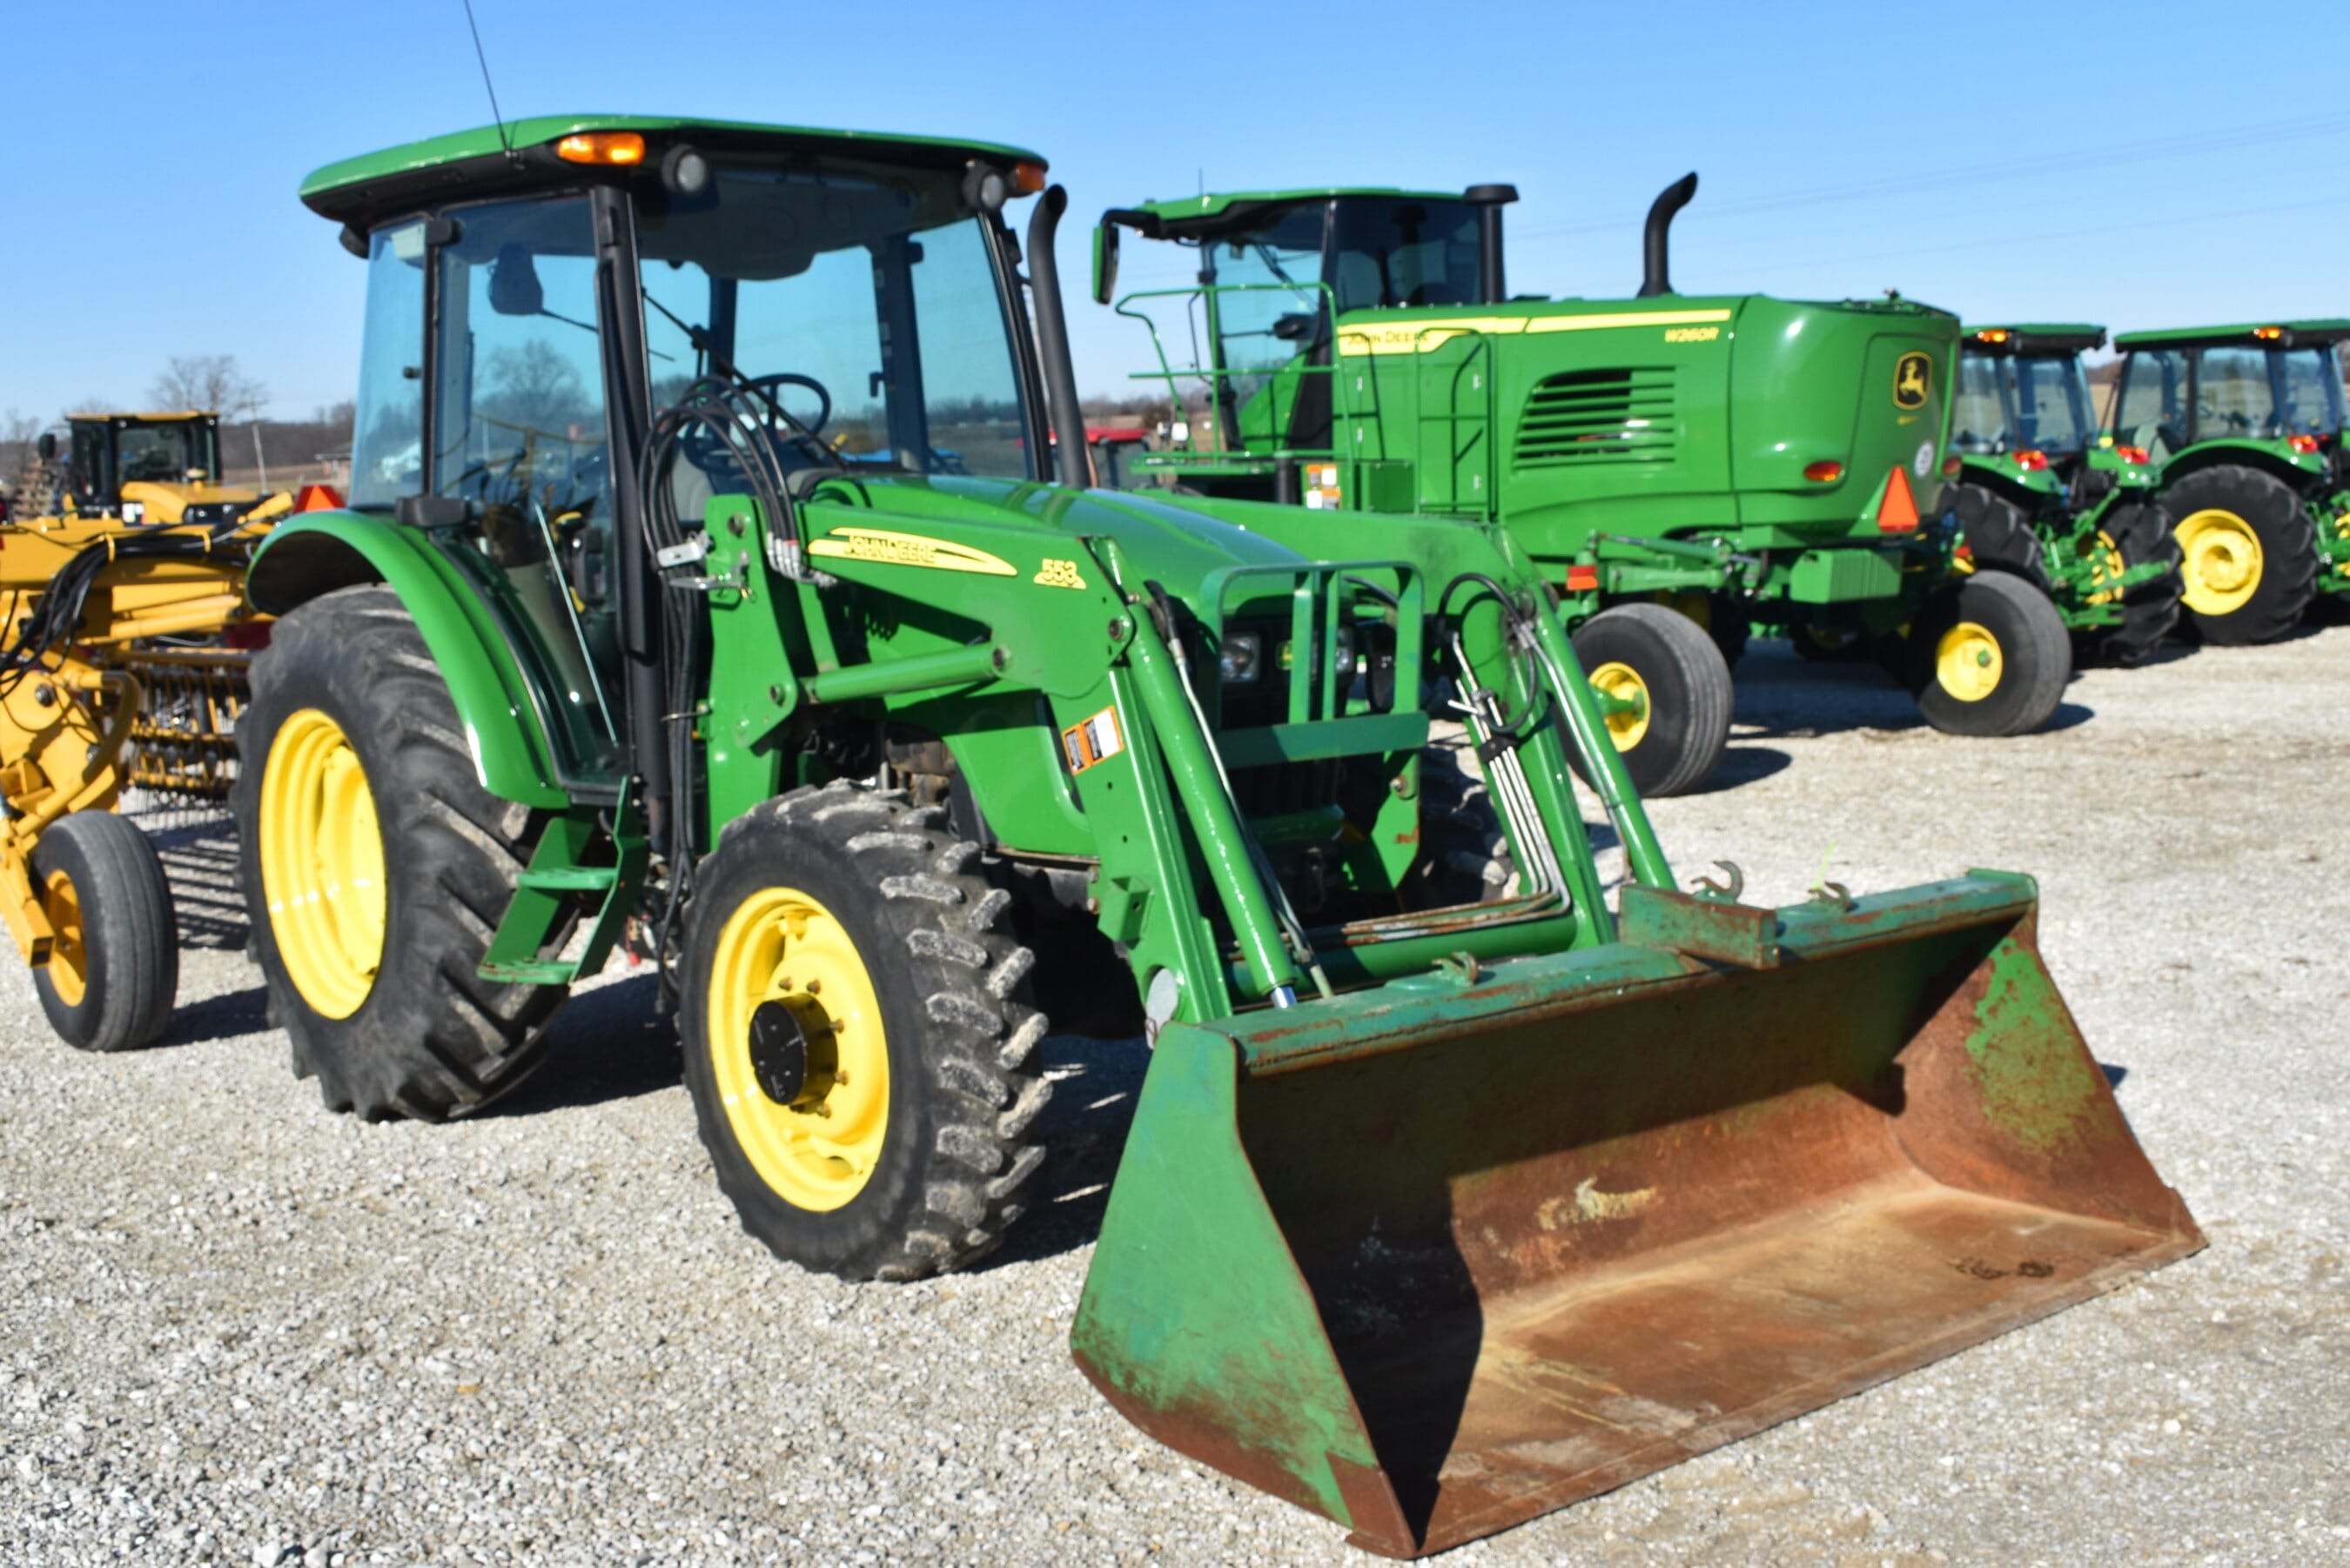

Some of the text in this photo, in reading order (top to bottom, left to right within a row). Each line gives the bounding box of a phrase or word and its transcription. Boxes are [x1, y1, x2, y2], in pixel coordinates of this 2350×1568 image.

[844, 535, 935, 564] JOHN DEERE
[1041, 558, 1078, 586] 553
